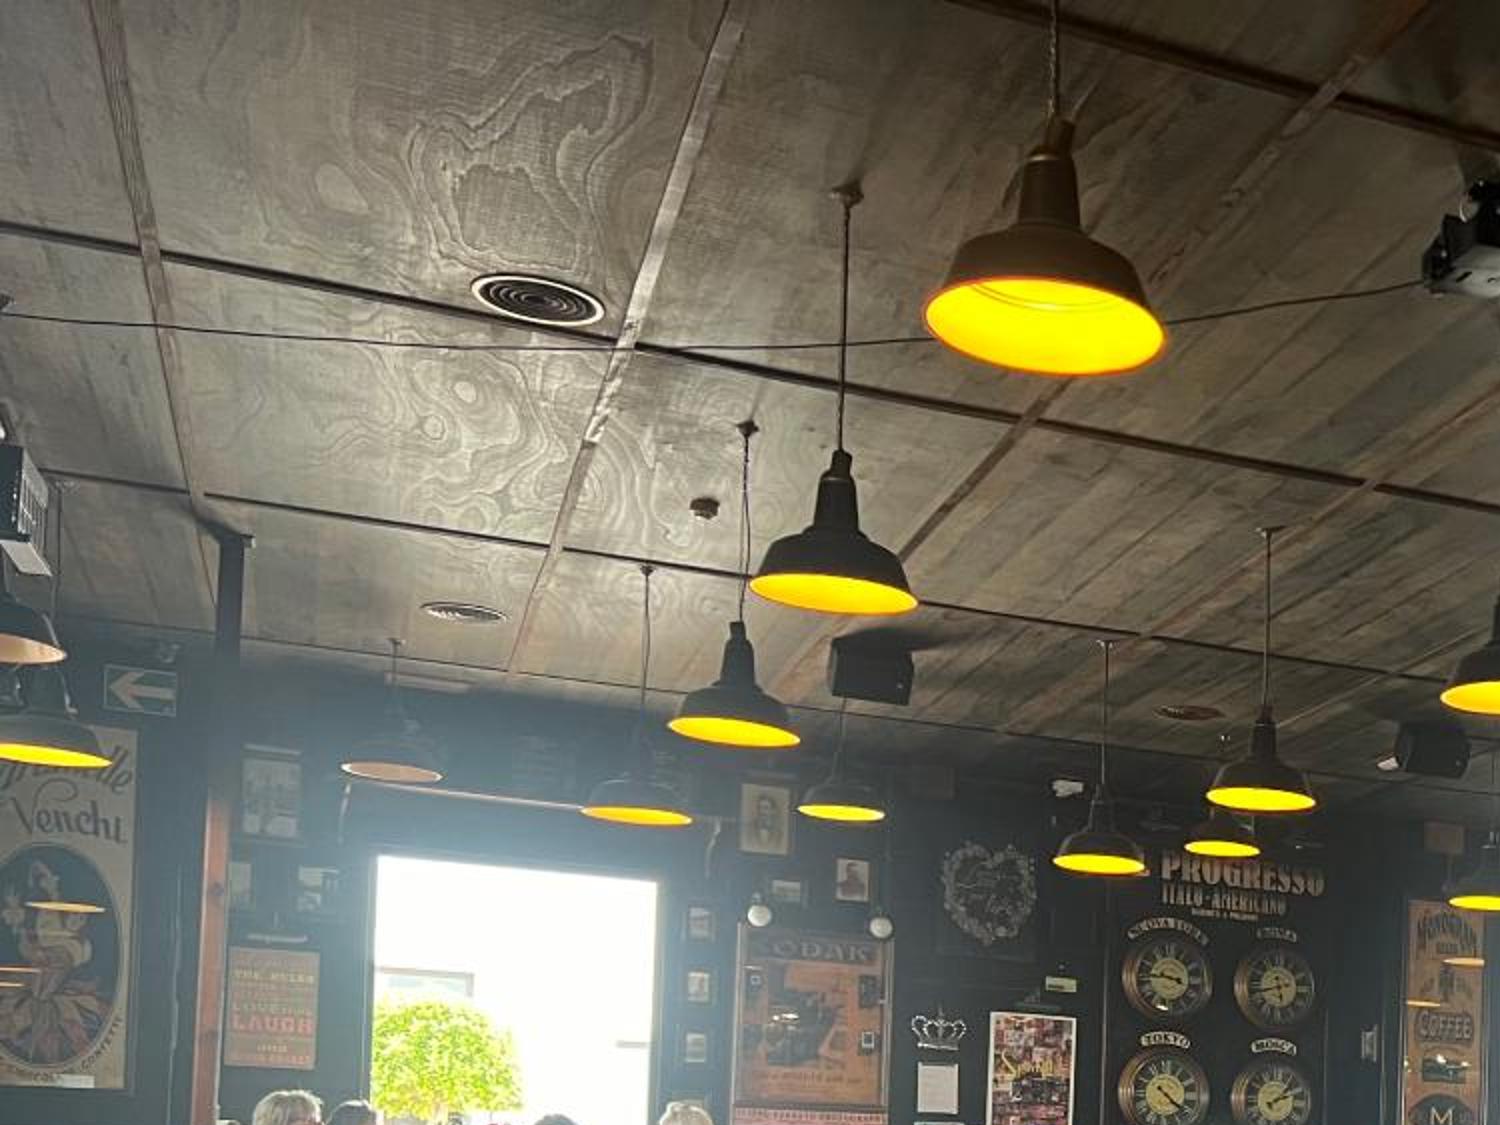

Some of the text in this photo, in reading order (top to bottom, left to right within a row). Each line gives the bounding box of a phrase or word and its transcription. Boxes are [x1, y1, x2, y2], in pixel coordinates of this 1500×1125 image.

[11, 777, 128, 844] Venchi
[1161, 851, 1325, 897] PROGRESSO
[1142, 1031, 1190, 1048] TOKYO
[1420, 1010, 1472, 1040] COFFEE
